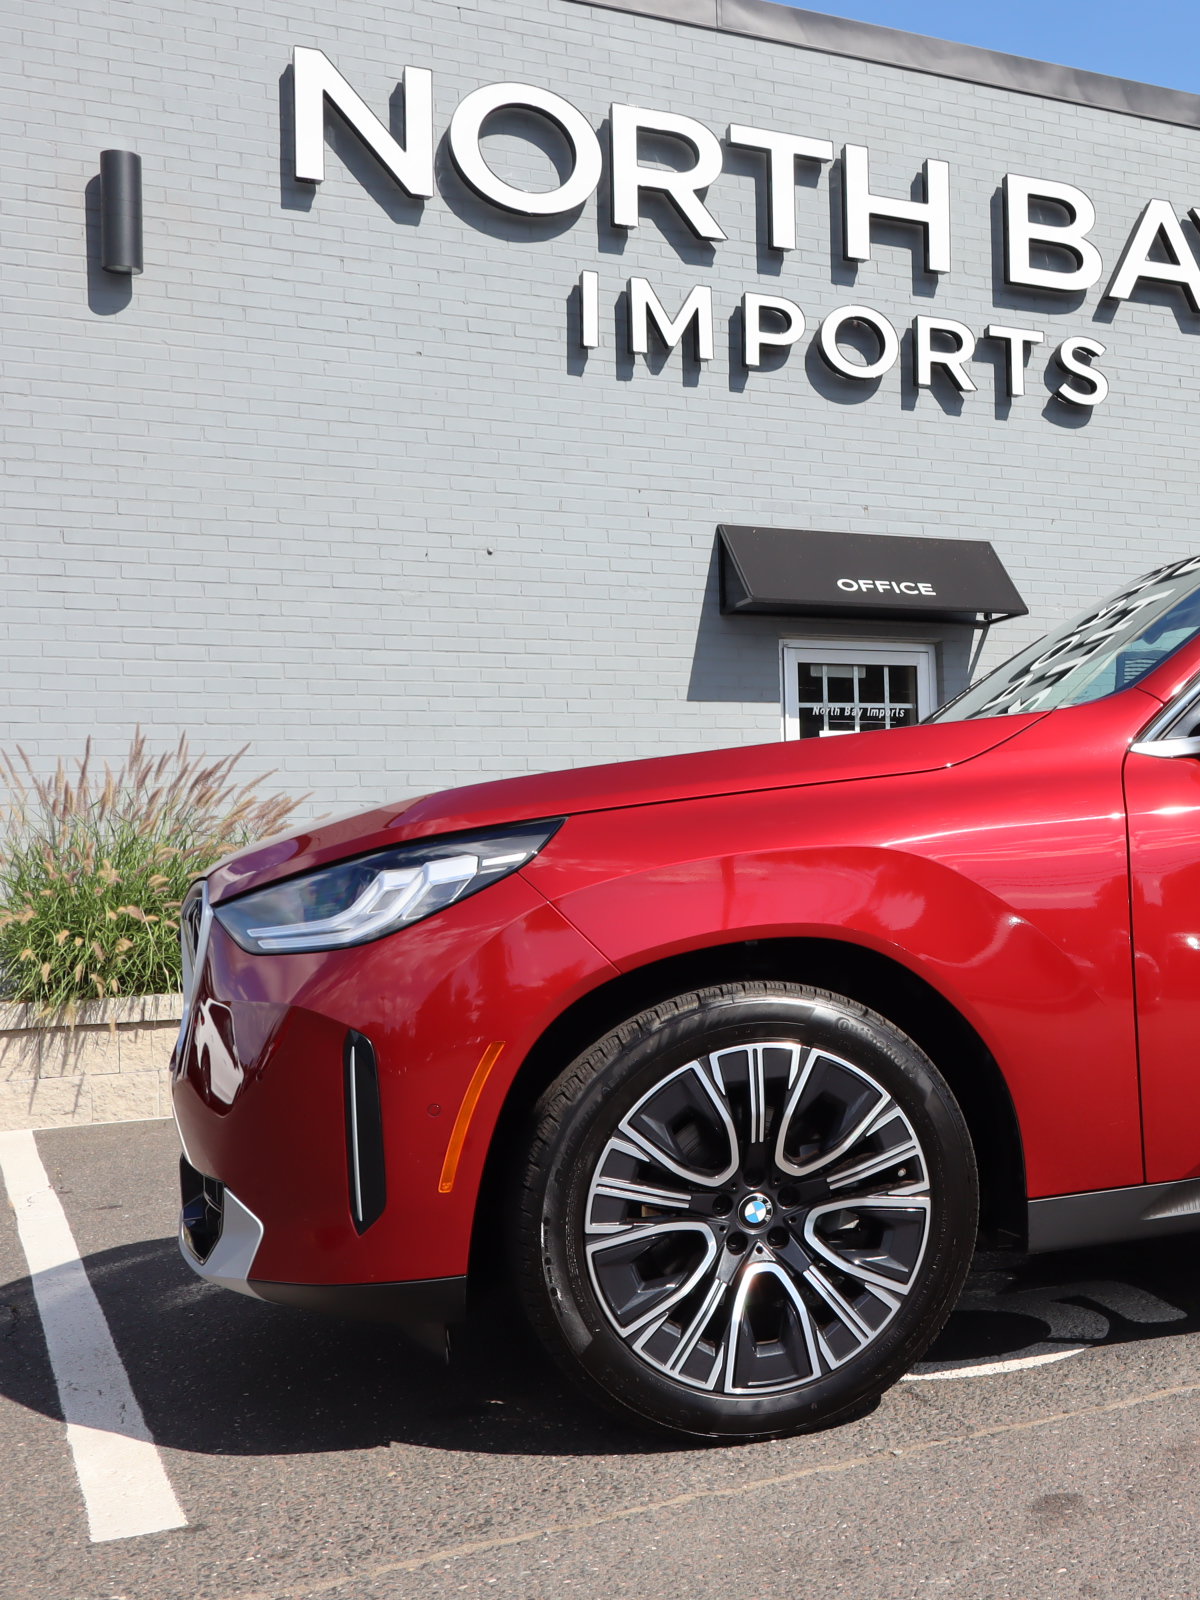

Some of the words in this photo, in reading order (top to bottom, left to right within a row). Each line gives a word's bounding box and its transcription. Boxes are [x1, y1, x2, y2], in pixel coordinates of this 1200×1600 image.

[293, 46, 951, 273] NORTH
[581, 270, 1110, 406] IMPORTS
[836, 578, 937, 596] OFFICE
[812, 705, 840, 716] North
[844, 706, 863, 718] Bay
[867, 707, 905, 719] Imports
